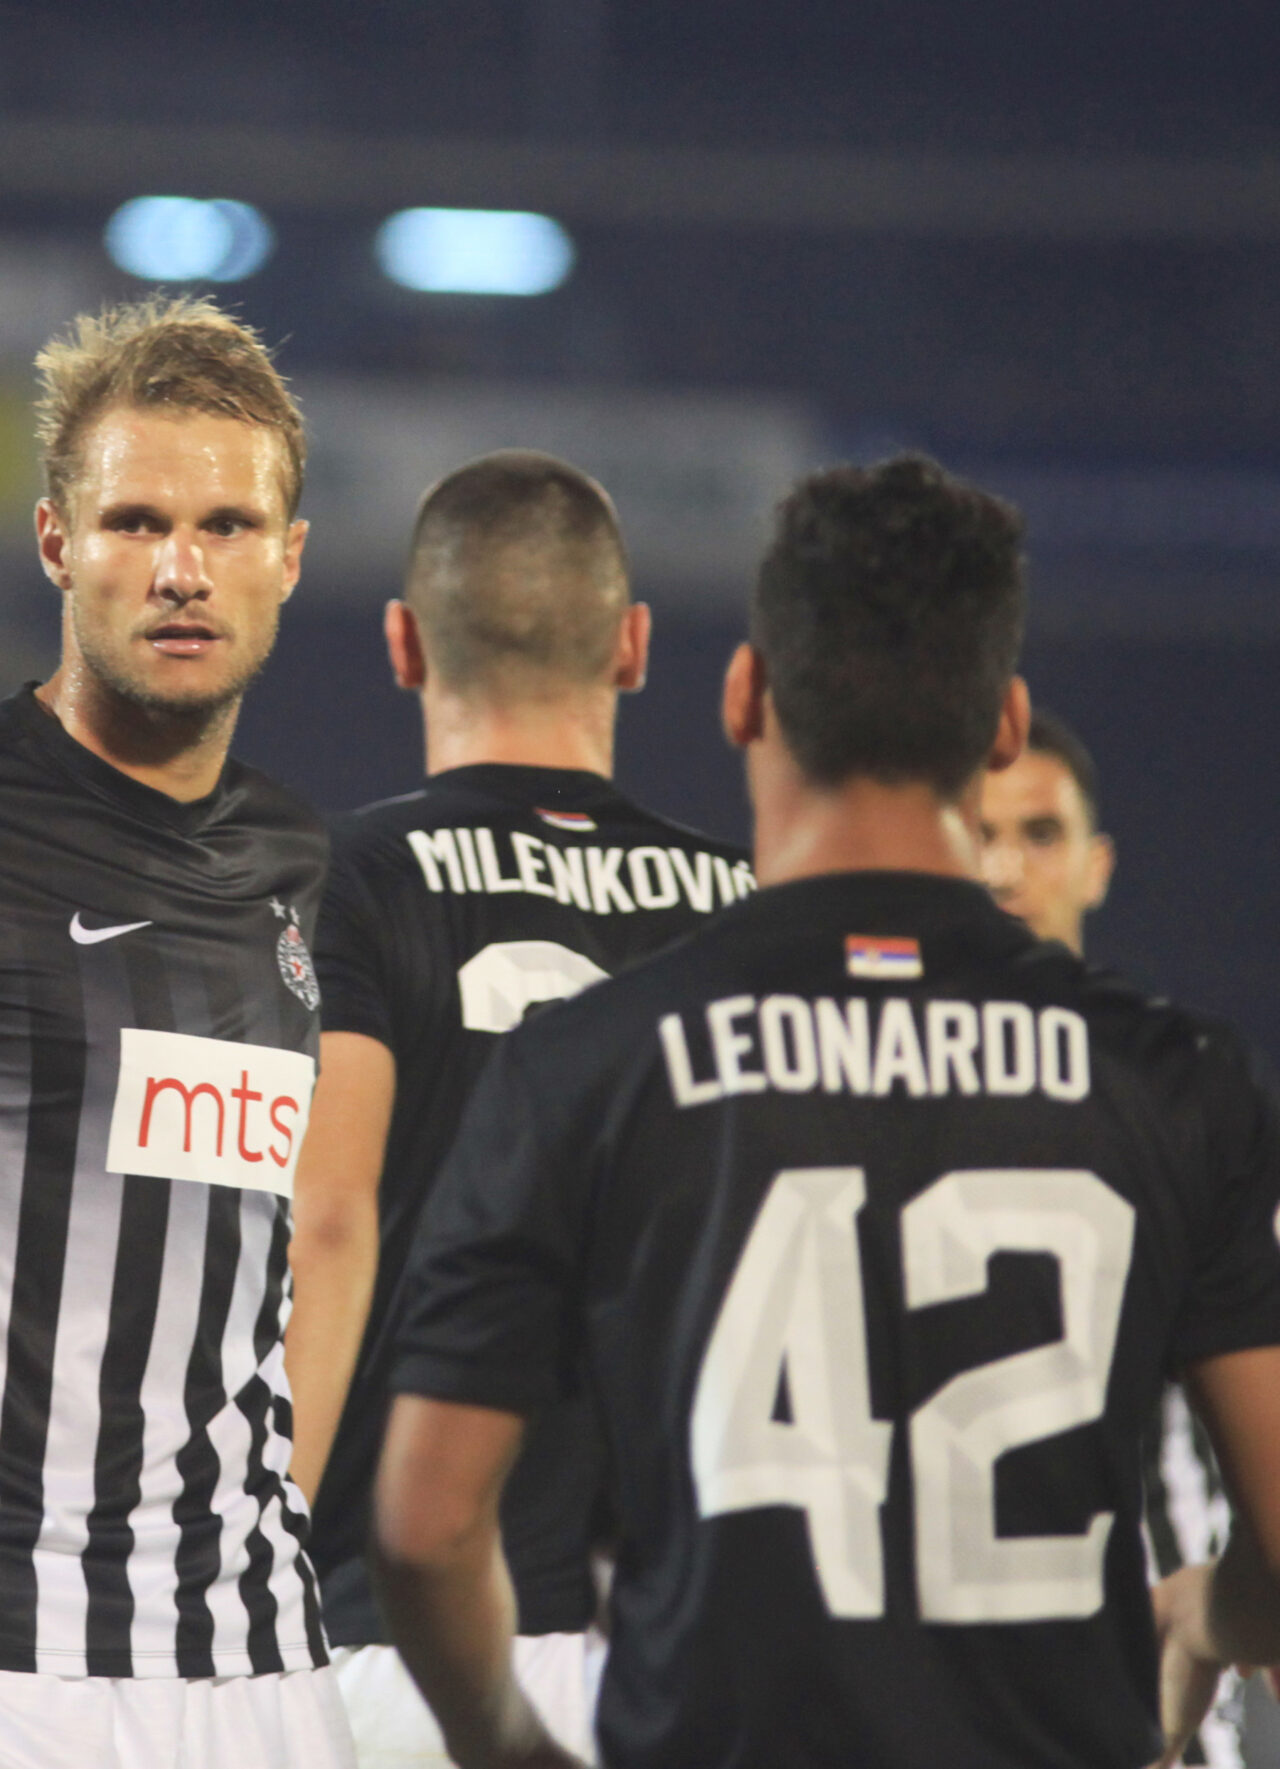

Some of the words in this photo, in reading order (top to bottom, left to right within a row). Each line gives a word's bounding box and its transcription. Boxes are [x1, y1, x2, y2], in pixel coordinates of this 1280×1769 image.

[658, 994, 1091, 1106] LEONARDO
[137, 1069, 299, 1168] mts
[689, 1166, 1136, 1625] 42
